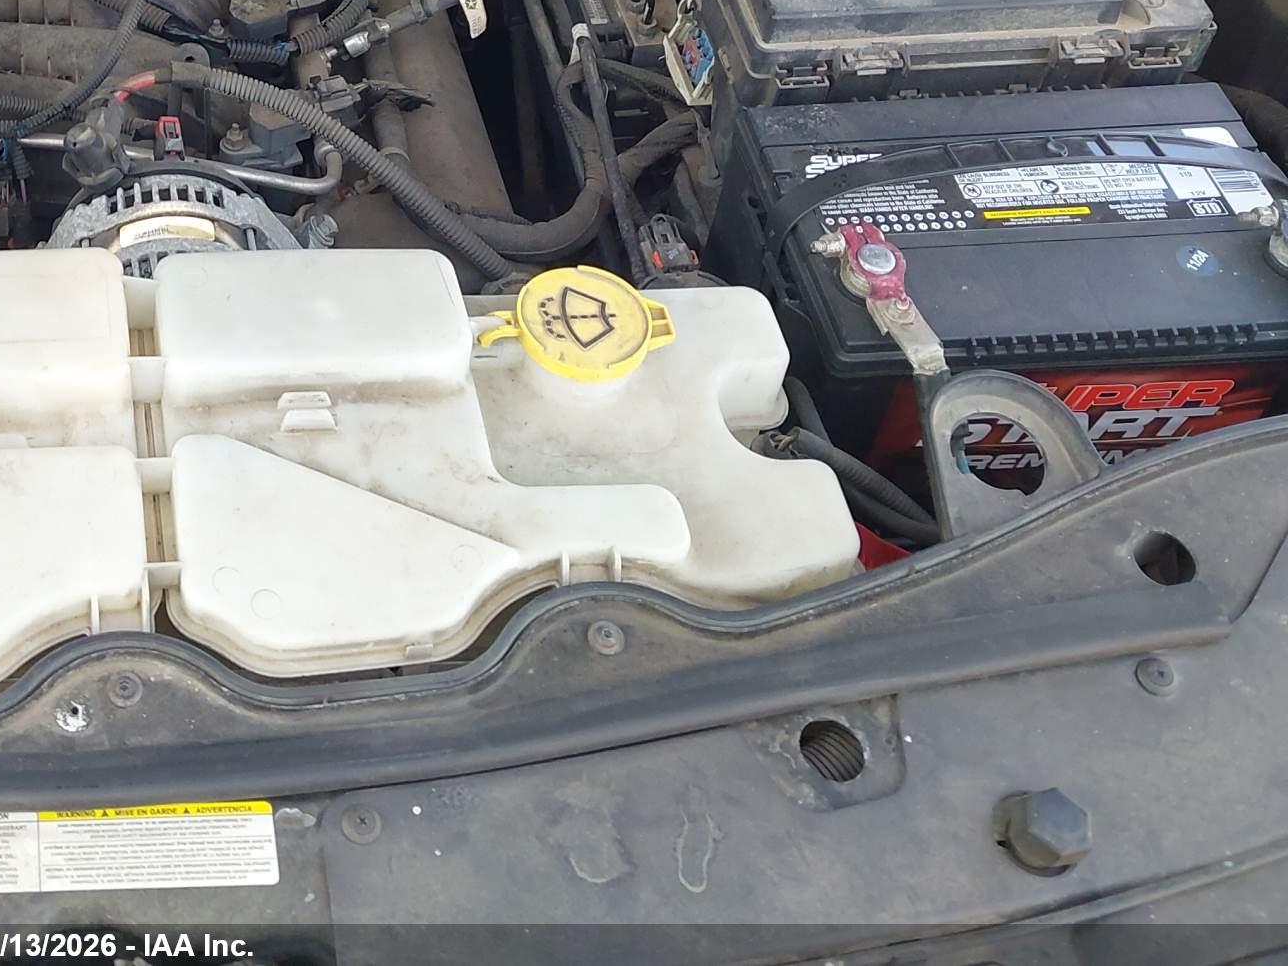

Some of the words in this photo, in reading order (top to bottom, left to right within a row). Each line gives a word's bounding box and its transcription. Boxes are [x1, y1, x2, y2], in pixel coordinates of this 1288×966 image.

[1193, 202, 1222, 214] STD
[1186, 249, 1209, 271] 11/24
[57, 810, 96, 818] WARNING
[196, 806, 252, 814] ADVERTENCIA
